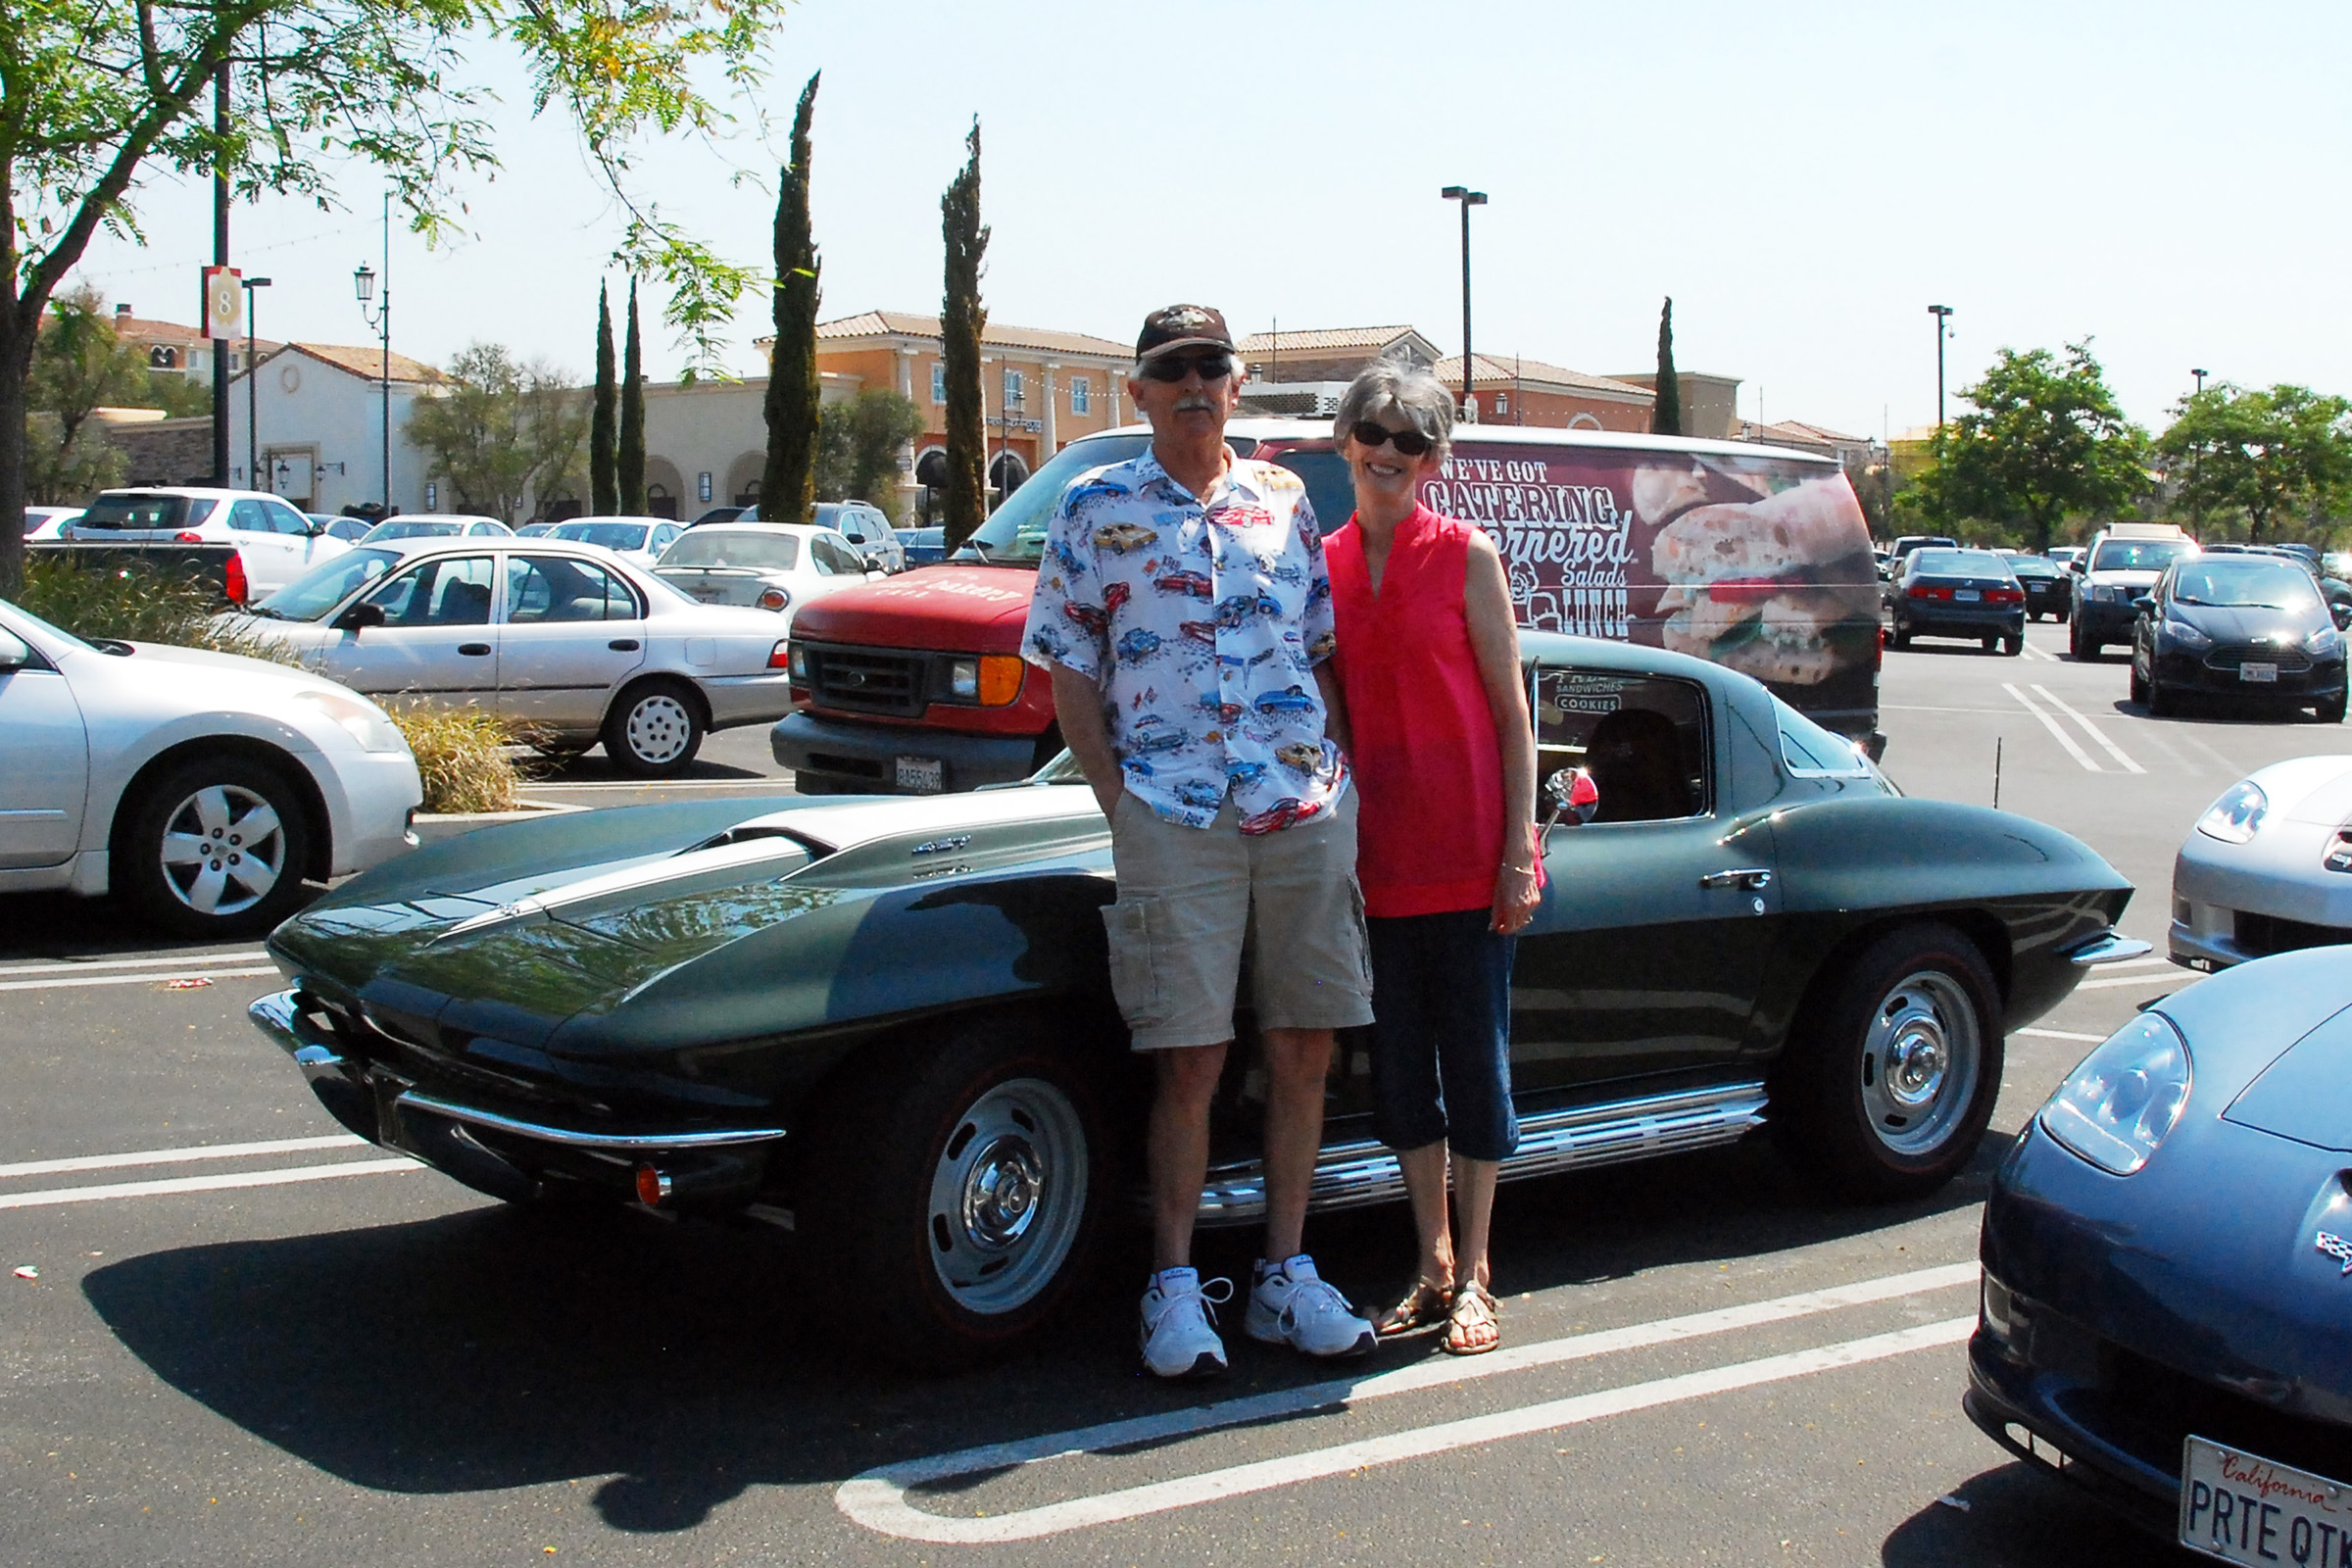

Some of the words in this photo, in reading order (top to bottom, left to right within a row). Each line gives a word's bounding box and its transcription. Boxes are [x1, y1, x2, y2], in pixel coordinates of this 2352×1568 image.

[220, 291, 231, 315] 8
[1440, 459, 1503, 481] WE'VE
[1507, 461, 1547, 483] GOT
[1423, 481, 1618, 530] CATERING
[1561, 559, 1628, 587] Salads
[1562, 589, 1629, 637] LUNCH
[1556, 682, 1623, 694] SANDWICHES
[1561, 699, 1616, 710] COOKIES
[2222, 1454, 2337, 1513] California
[2188, 1480, 2280, 1561] PRTE
